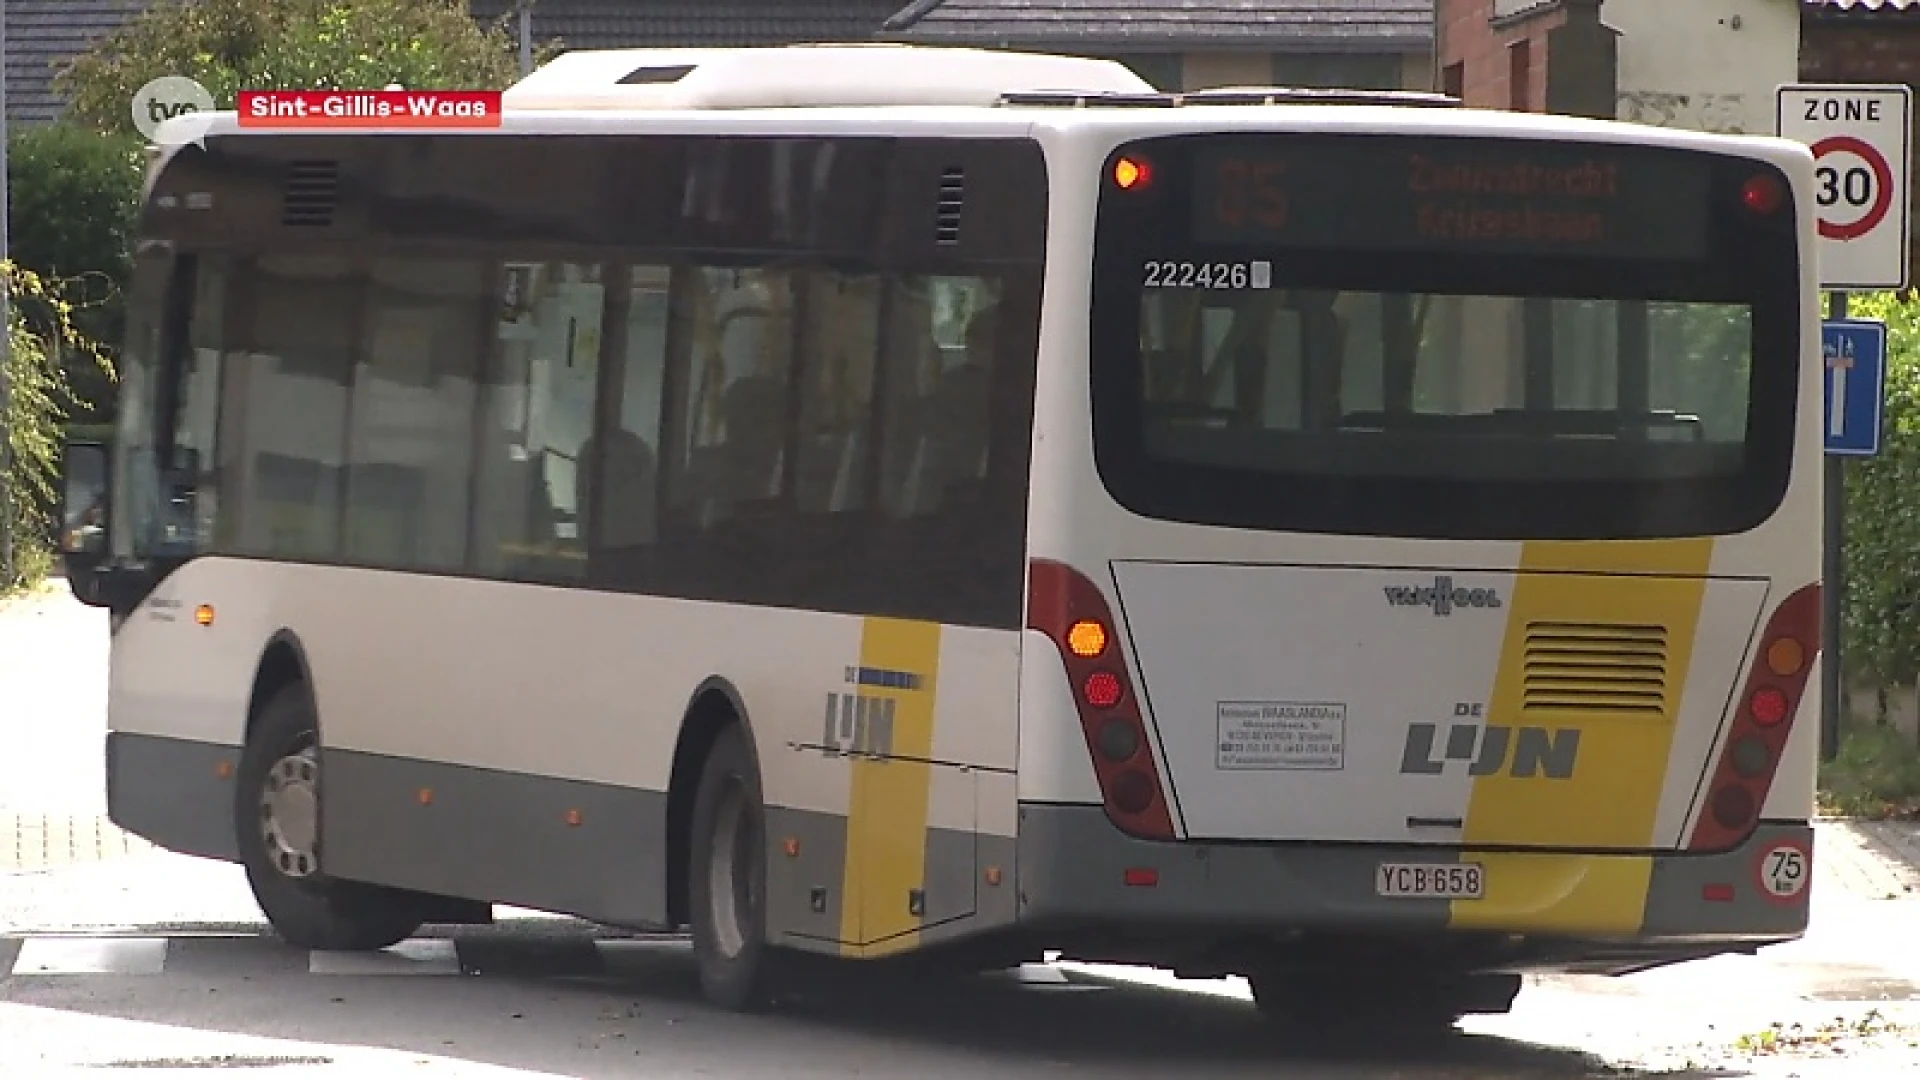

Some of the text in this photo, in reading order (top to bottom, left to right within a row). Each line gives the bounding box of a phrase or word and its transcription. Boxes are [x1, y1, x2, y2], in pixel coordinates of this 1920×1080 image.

[1804, 99, 1881, 121] ZONE
[1815, 167, 1871, 206] 30
[1144, 261, 1247, 289] 222426
[1454, 702, 1482, 716] DE
[1400, 722, 1581, 778] LIJN
[1771, 851, 1801, 878] 75
